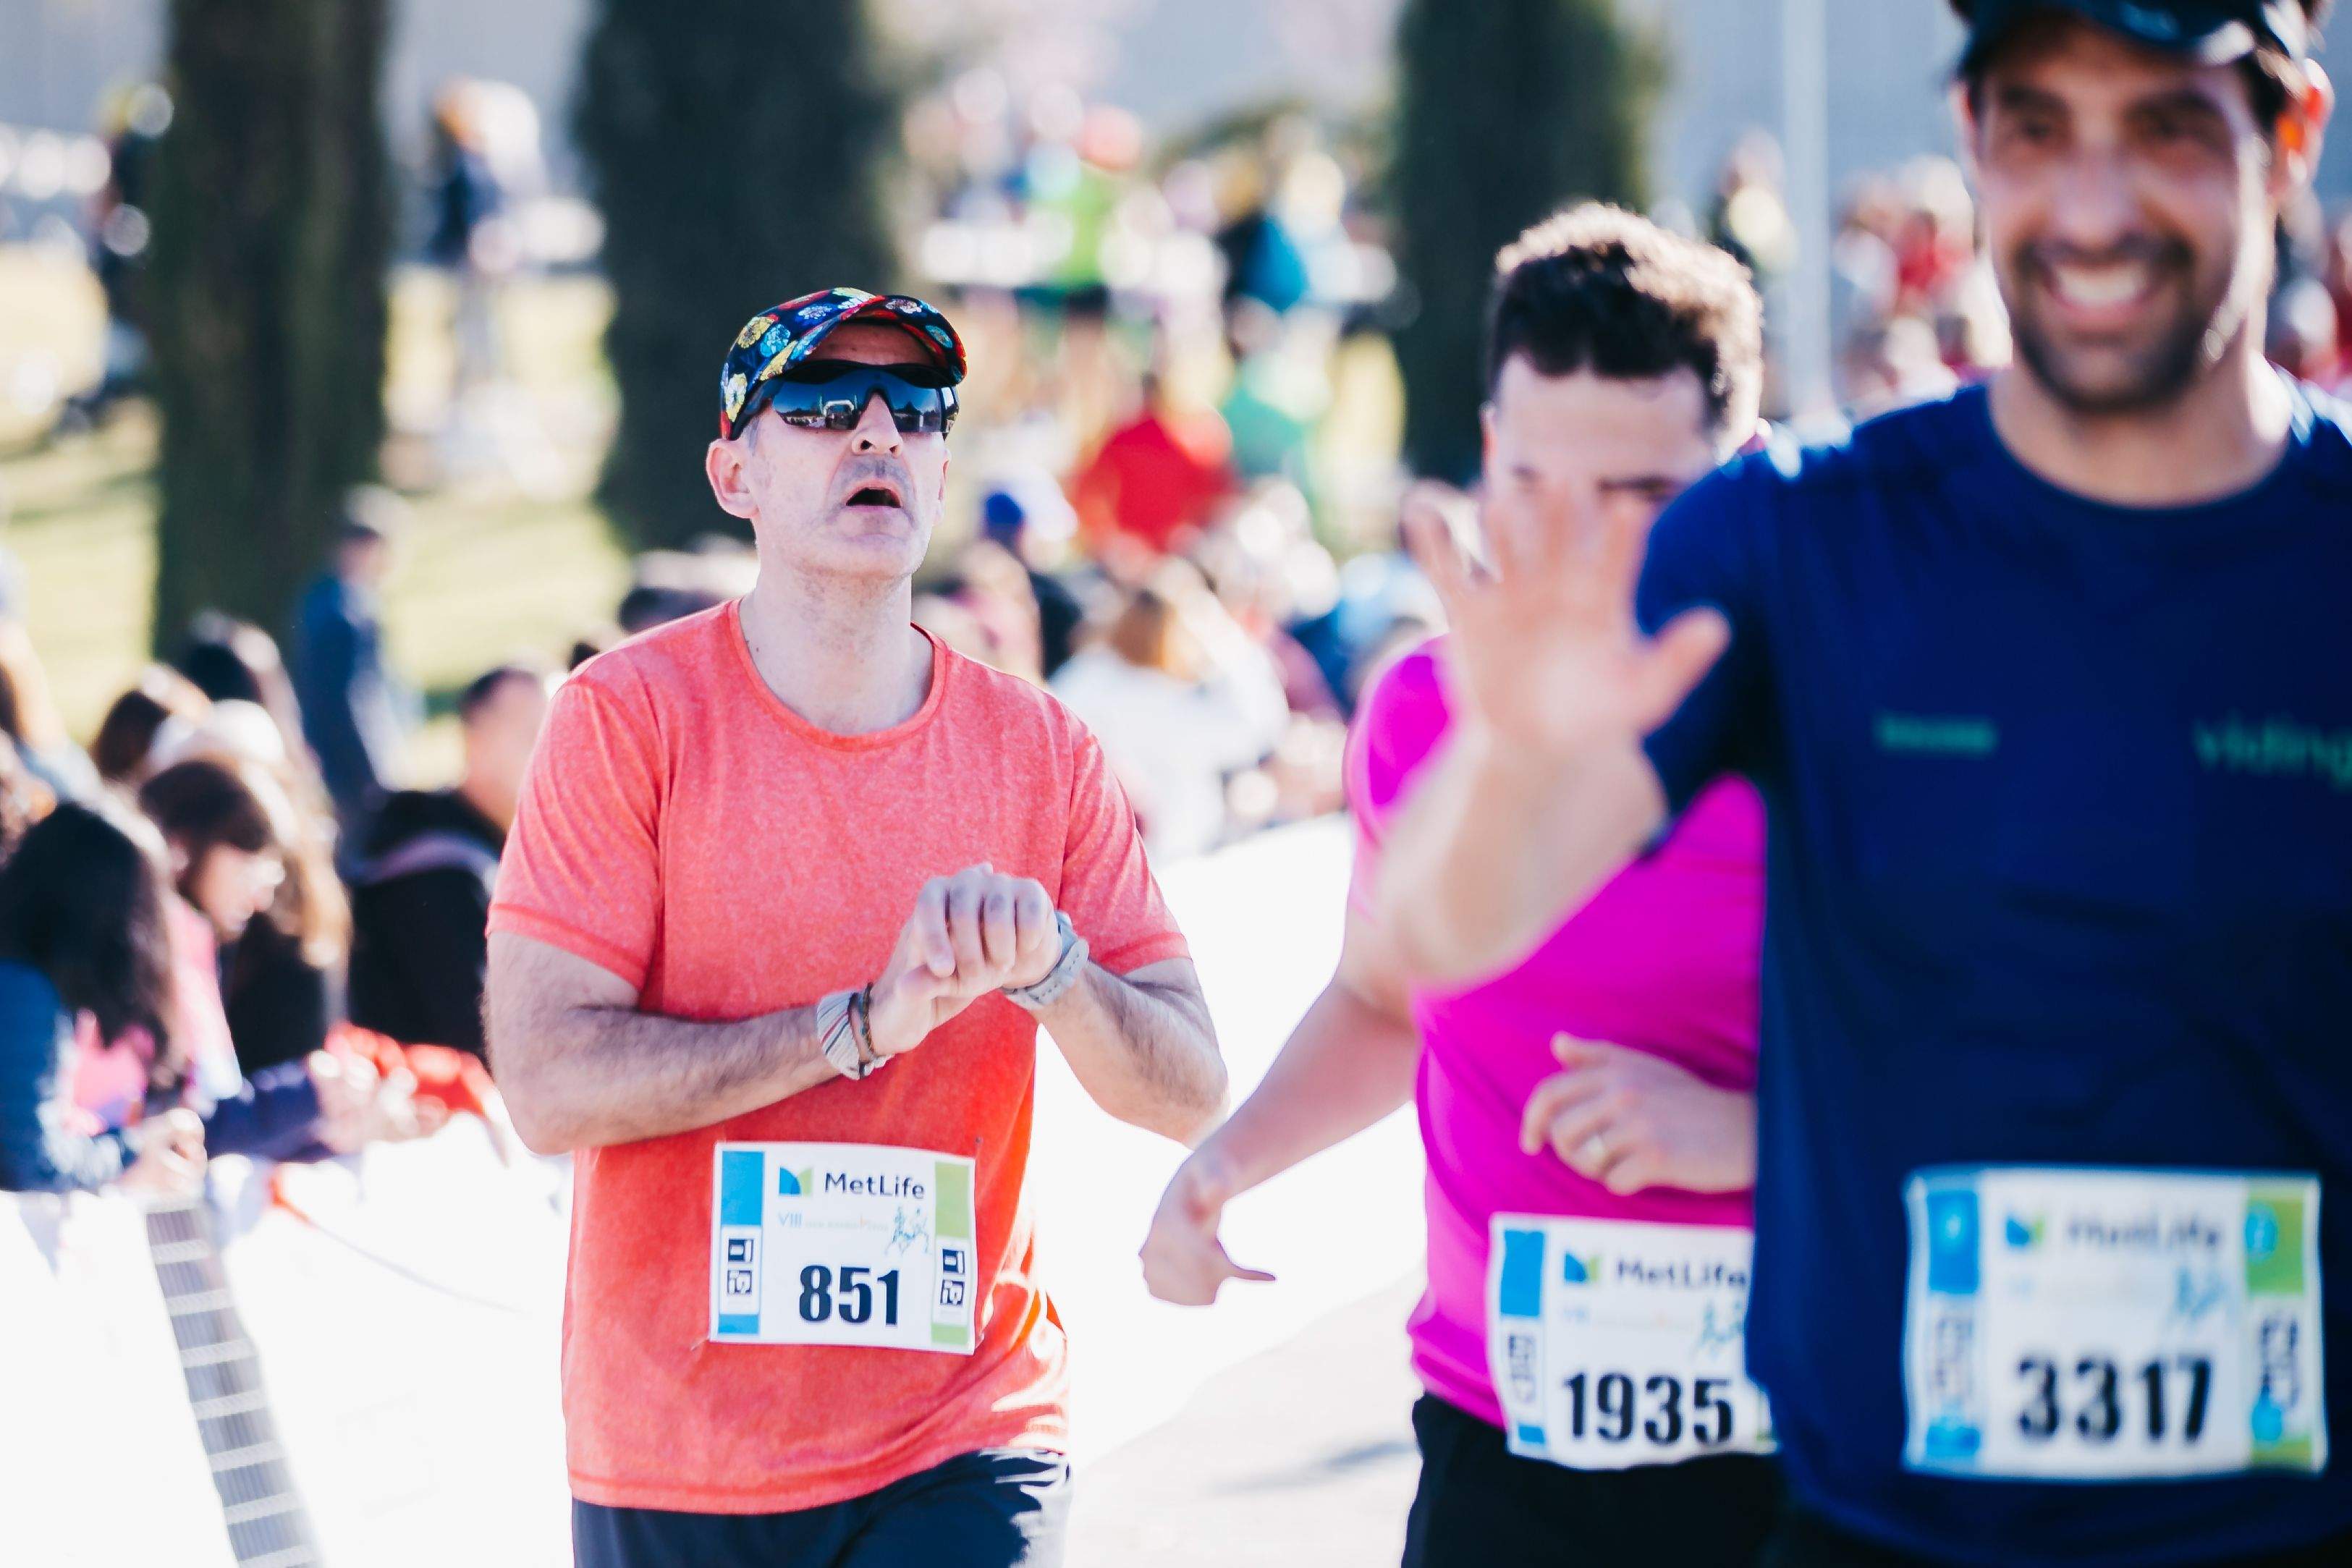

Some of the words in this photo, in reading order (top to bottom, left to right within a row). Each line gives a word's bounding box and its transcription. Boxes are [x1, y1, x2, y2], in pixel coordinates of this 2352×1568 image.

[824, 1172, 925, 1199] MetLife
[777, 1212, 803, 1228] VIII
[798, 1265, 900, 1326] 851
[1563, 1372, 1734, 1445] 1935
[2018, 1355, 2212, 1443] 3317
